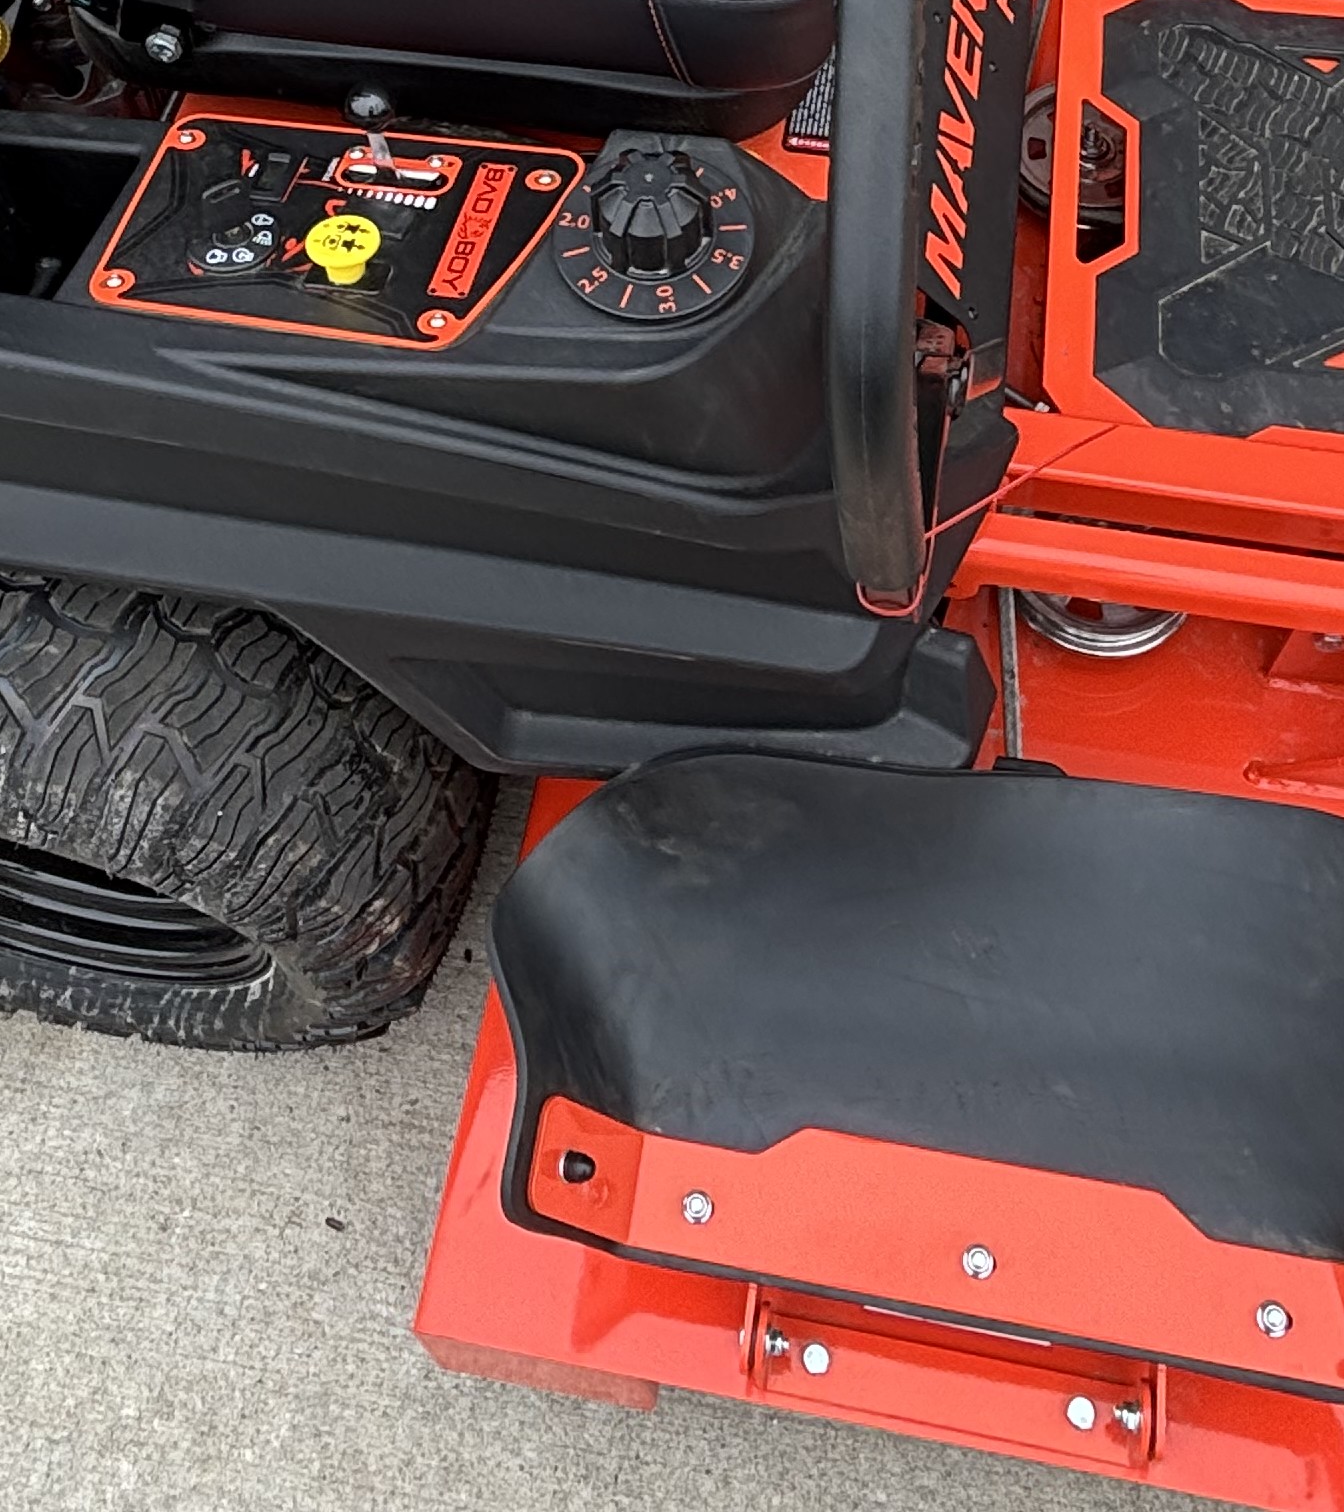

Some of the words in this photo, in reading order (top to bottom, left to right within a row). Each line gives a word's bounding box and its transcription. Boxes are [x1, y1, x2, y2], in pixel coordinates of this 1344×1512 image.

[471, 167, 506, 214] BAD
[710, 188, 738, 210] 4.0
[558, 211, 591, 230] 2.0
[441, 239, 477, 292] BOY
[710, 248, 746, 271] 3.5
[576, 266, 609, 295] 2.5
[655, 284, 677, 314] 3.0
